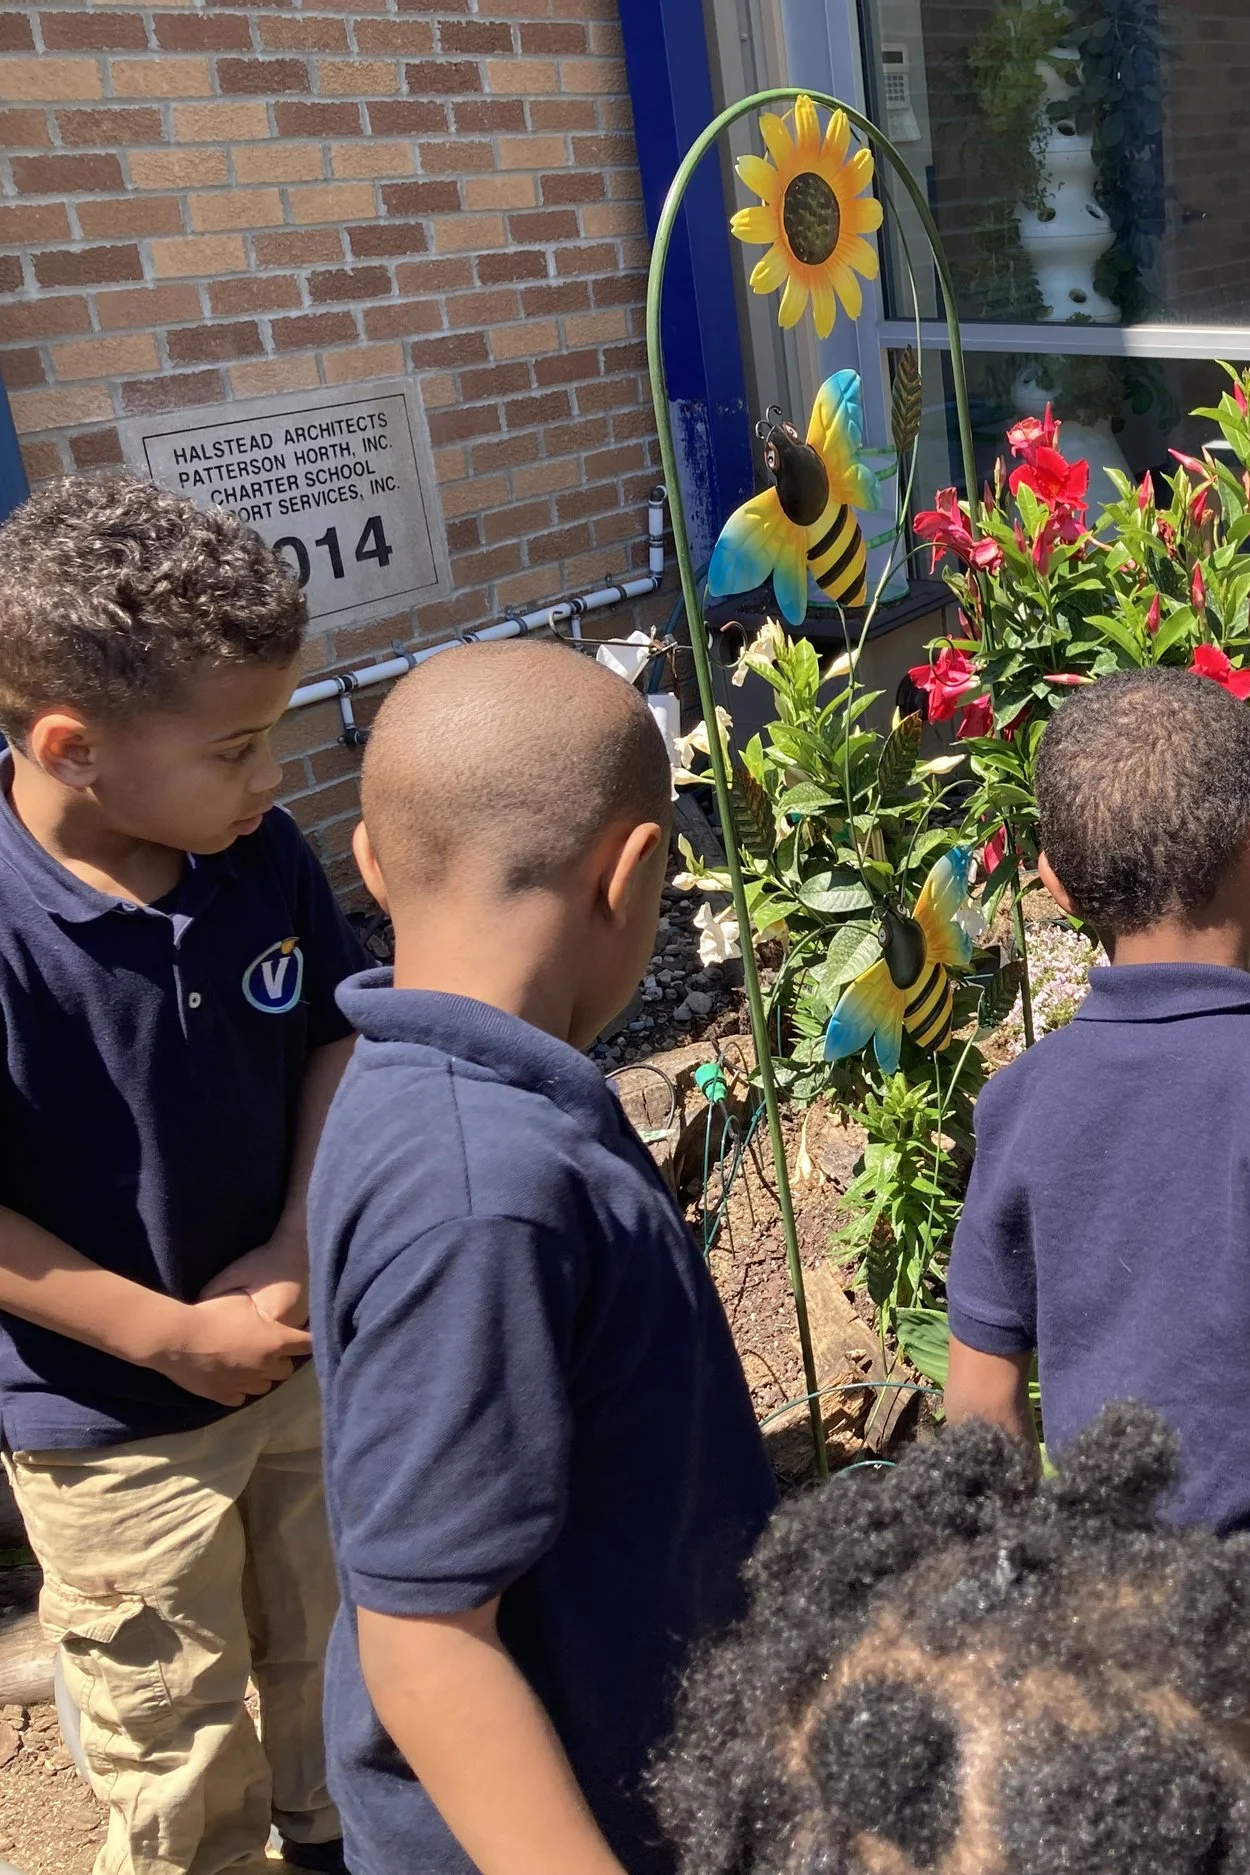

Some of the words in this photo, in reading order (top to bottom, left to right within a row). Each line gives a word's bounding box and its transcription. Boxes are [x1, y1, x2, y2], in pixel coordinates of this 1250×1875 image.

[173, 433, 273, 465] HALSTEAD
[284, 412, 388, 445] ARCHITECTS
[179, 454, 286, 488] PATTERSON
[294, 441, 356, 466] HORTH,
[362, 434, 392, 453] INC.
[211, 475, 299, 505] CHARTER
[304, 460, 376, 487] SCHOOL
[230, 502, 272, 523] ORT
[279, 484, 364, 515] SERVICES,
[370, 476, 400, 495] INC.
[271, 515, 393, 590] 014
[261, 956, 291, 1000] V
